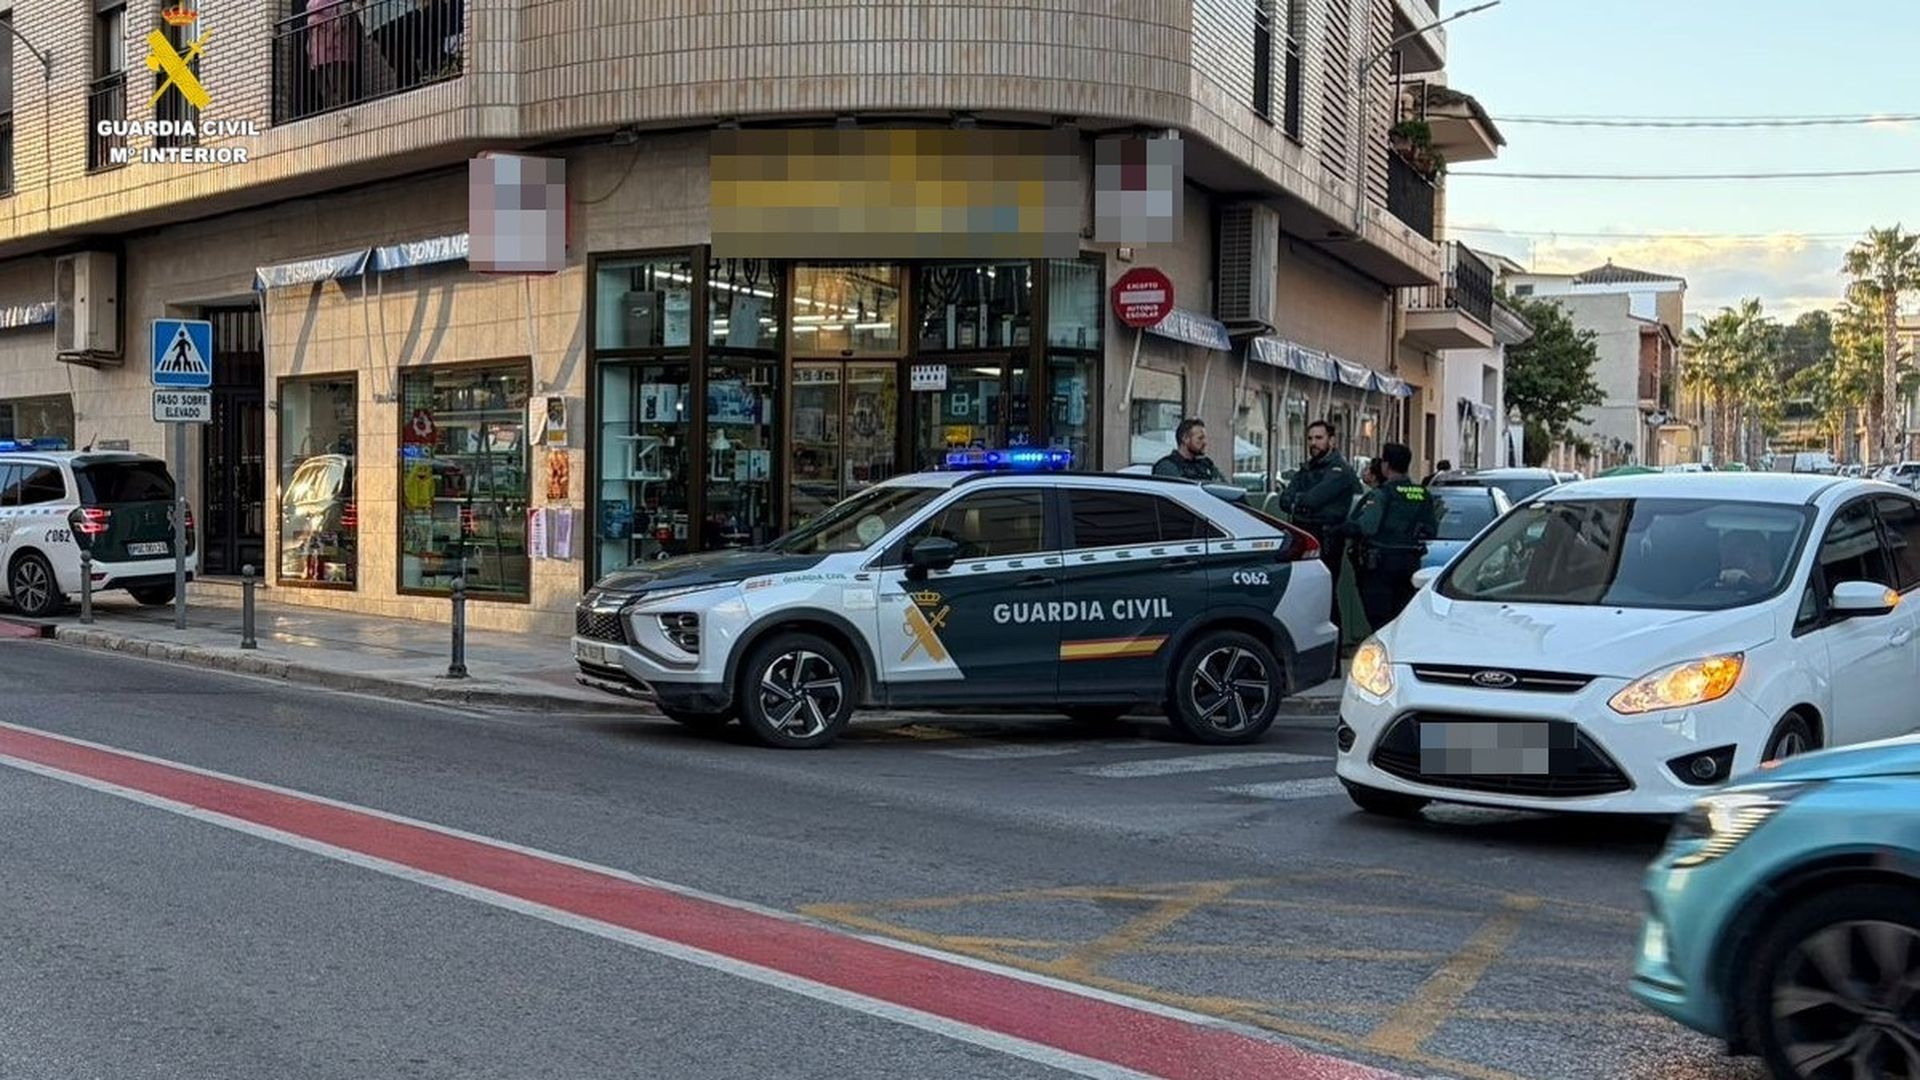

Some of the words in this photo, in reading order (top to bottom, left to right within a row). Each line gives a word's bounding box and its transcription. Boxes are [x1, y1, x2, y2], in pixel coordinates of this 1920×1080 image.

[1126, 282, 1158, 290] EXCEPTO
[1126, 311, 1158, 319] ESCOLAR
[157, 394, 178, 406] PASO
[181, 394, 208, 406] SOBRE
[165, 406, 201, 418] ELEVADO
[993, 600, 1104, 623] GUARDIA
[1112, 598, 1173, 620] CIVIL
